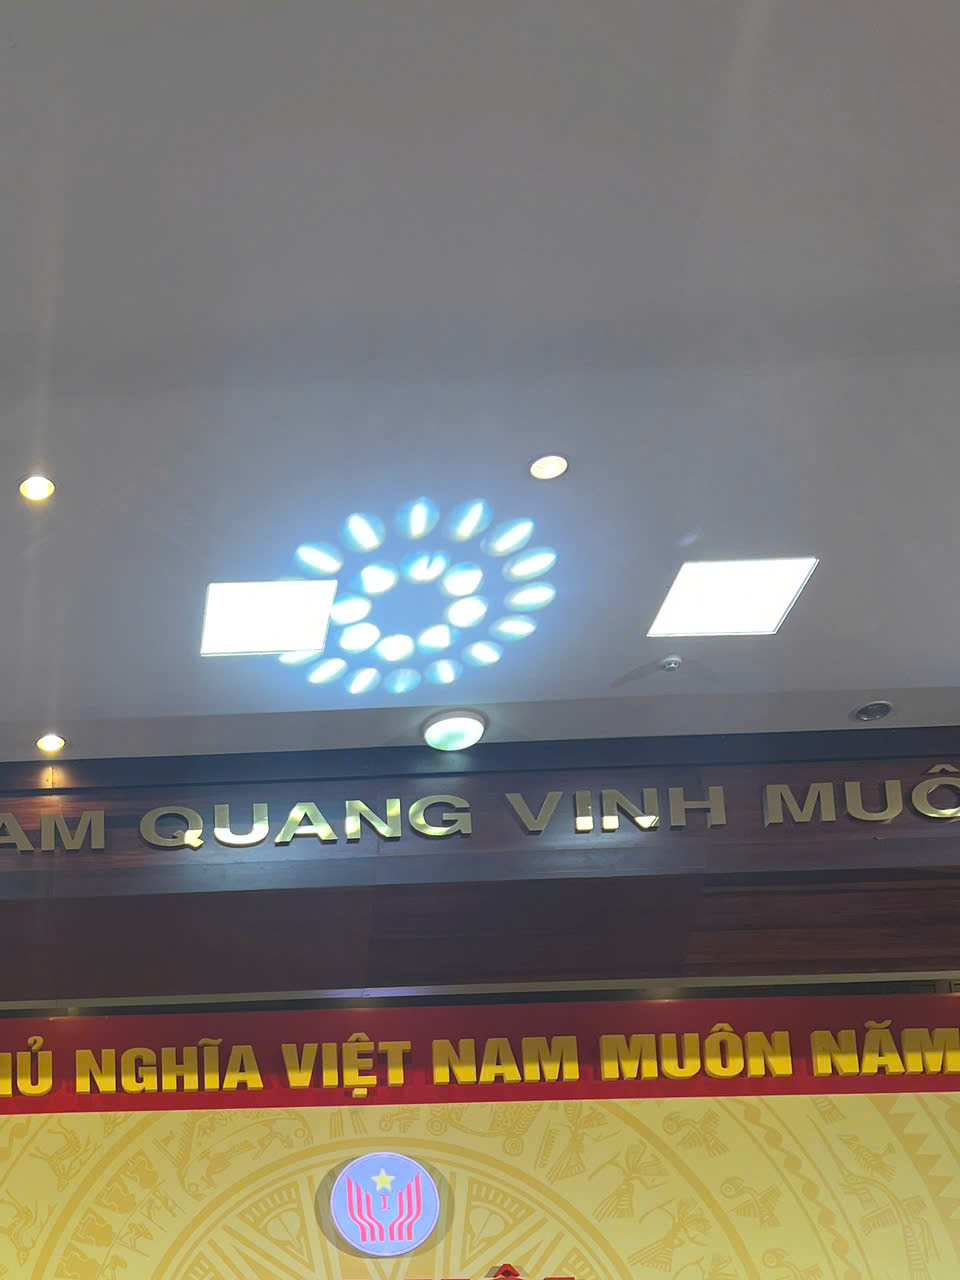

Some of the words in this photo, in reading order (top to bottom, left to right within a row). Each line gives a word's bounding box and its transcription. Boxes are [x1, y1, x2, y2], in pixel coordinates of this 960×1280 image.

[140, 794, 472, 850] QUANG
[505, 786, 727, 836] VINH
[765, 764, 960, 828] MUÔ
[74, 1037, 264, 1095] NGHĨA
[281, 1032, 412, 1098] VIỆT
[433, 1035, 580, 1086] NAM
[599, 1023, 793, 1082] MUÔN
[810, 1019, 960, 1077] NĂM
